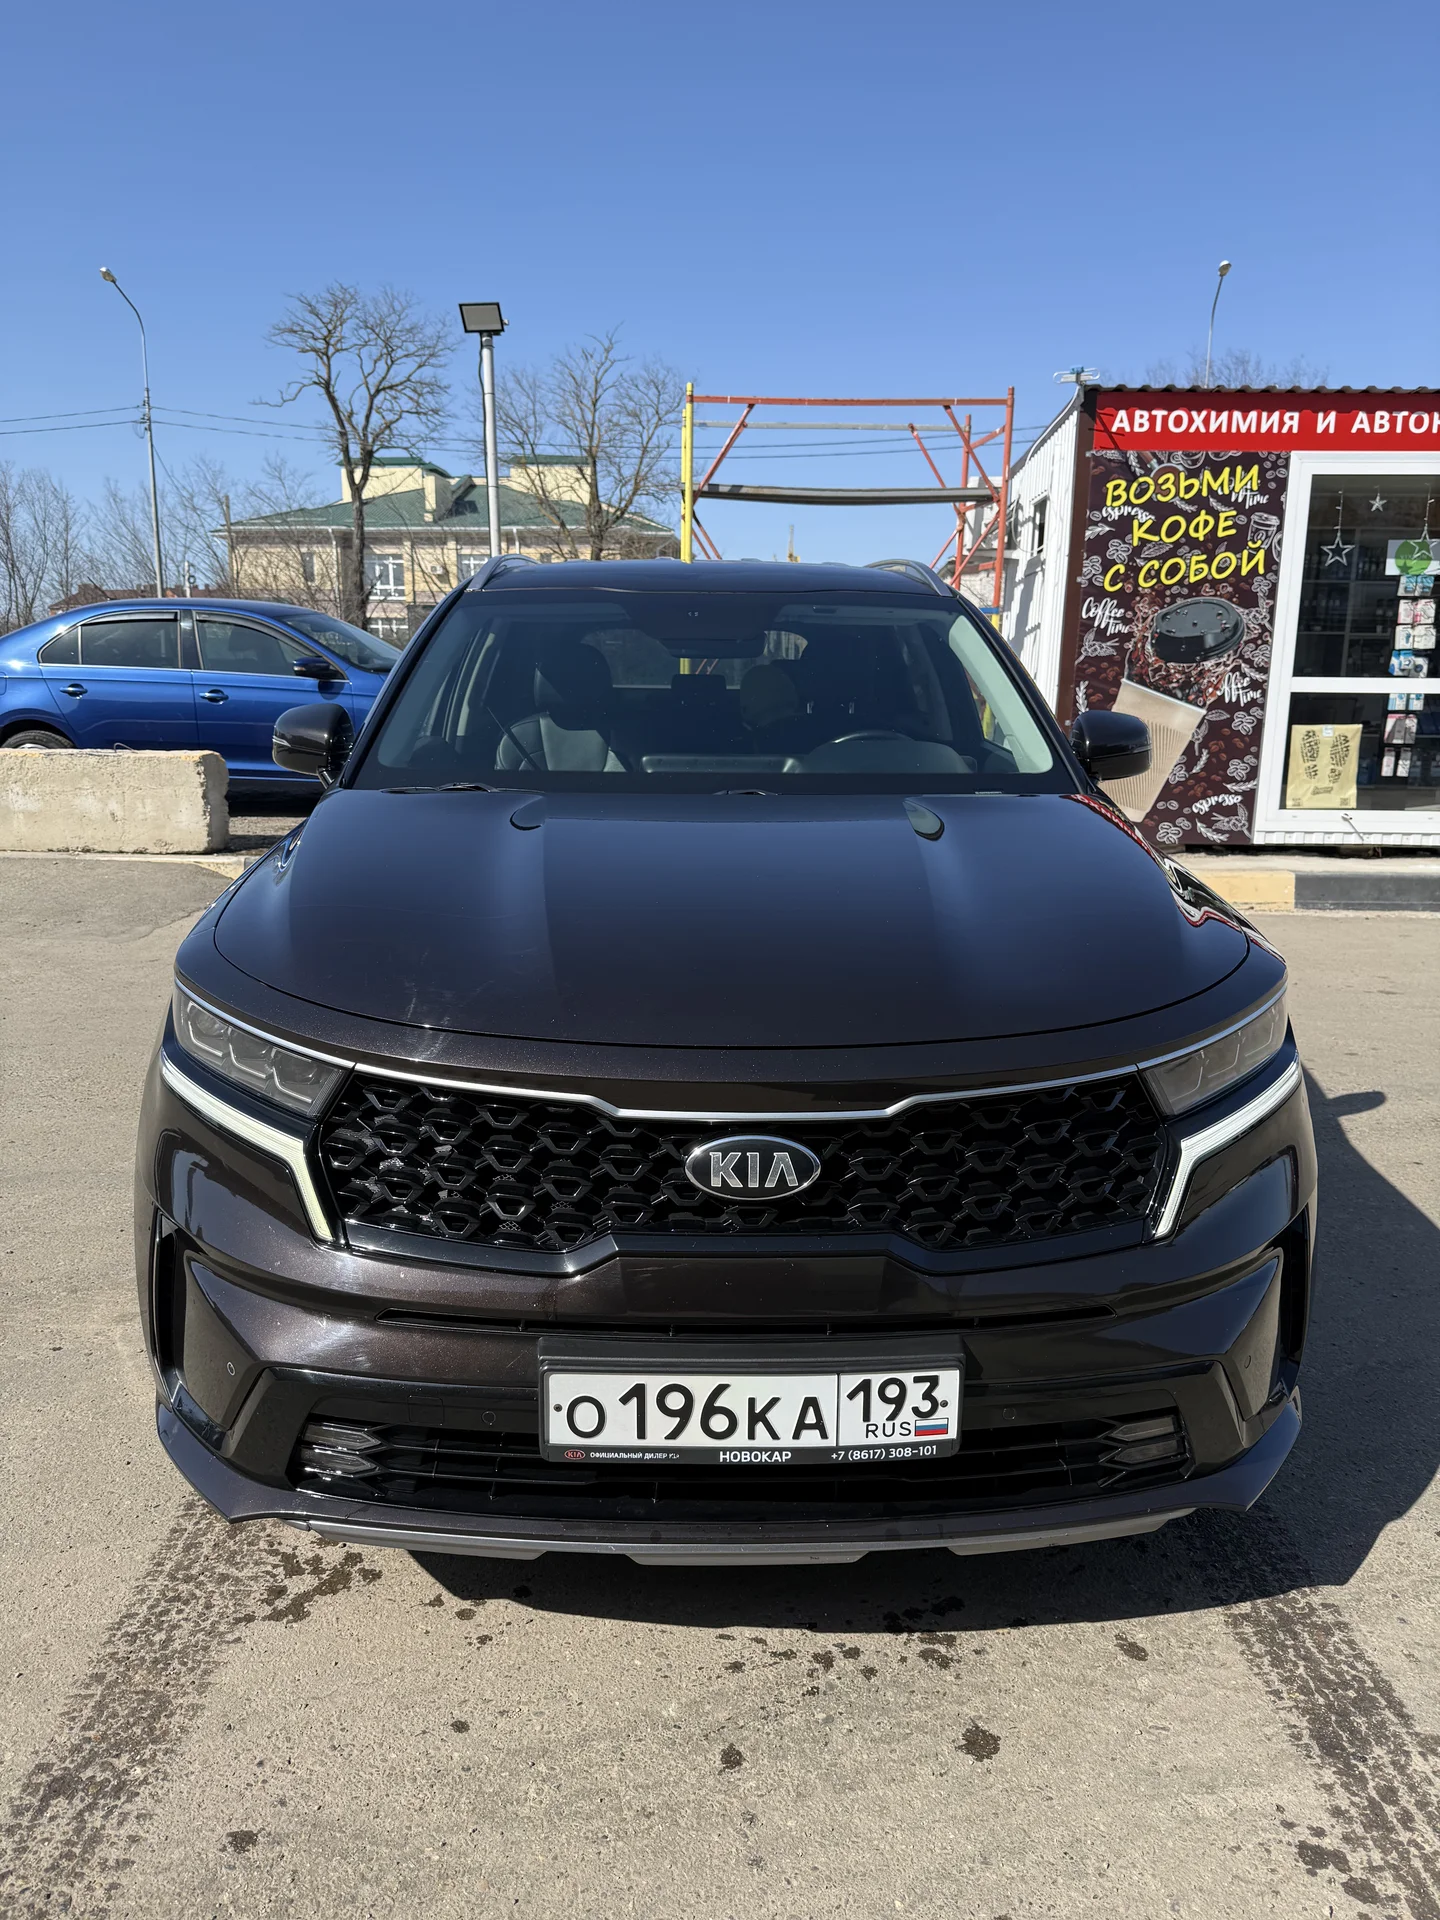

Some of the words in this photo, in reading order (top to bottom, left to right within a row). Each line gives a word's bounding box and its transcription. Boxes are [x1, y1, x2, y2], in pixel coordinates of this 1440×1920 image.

[1110, 409, 1300, 435] АВТОХИМИЯ
[1316, 410, 1338, 435] И
[1105, 464, 1260, 508] ВОЗЬМИ
[1131, 509, 1238, 547] КОФЕ
[1103, 562, 1126, 593] С
[1137, 539, 1266, 589] СОБОЙ
[1081, 596, 1126, 629] Coffee
[1191, 793, 1243, 815] espresso
[708, 1151, 799, 1188] KIA
[845, 1374, 940, 1423] 193
[865, 1419, 912, 1439] RUS
[589, 1451, 643, 1459] ОФИЦИАЛЬНЫЙ
[644, 1452, 668, 1460] ДИЛЕР
[719, 1450, 792, 1463] НОВОКАР
[831, 1451, 845, 1461] +7
[847, 1449, 886, 1461] (8617)
[888, 1445, 938, 1459] 308-101
